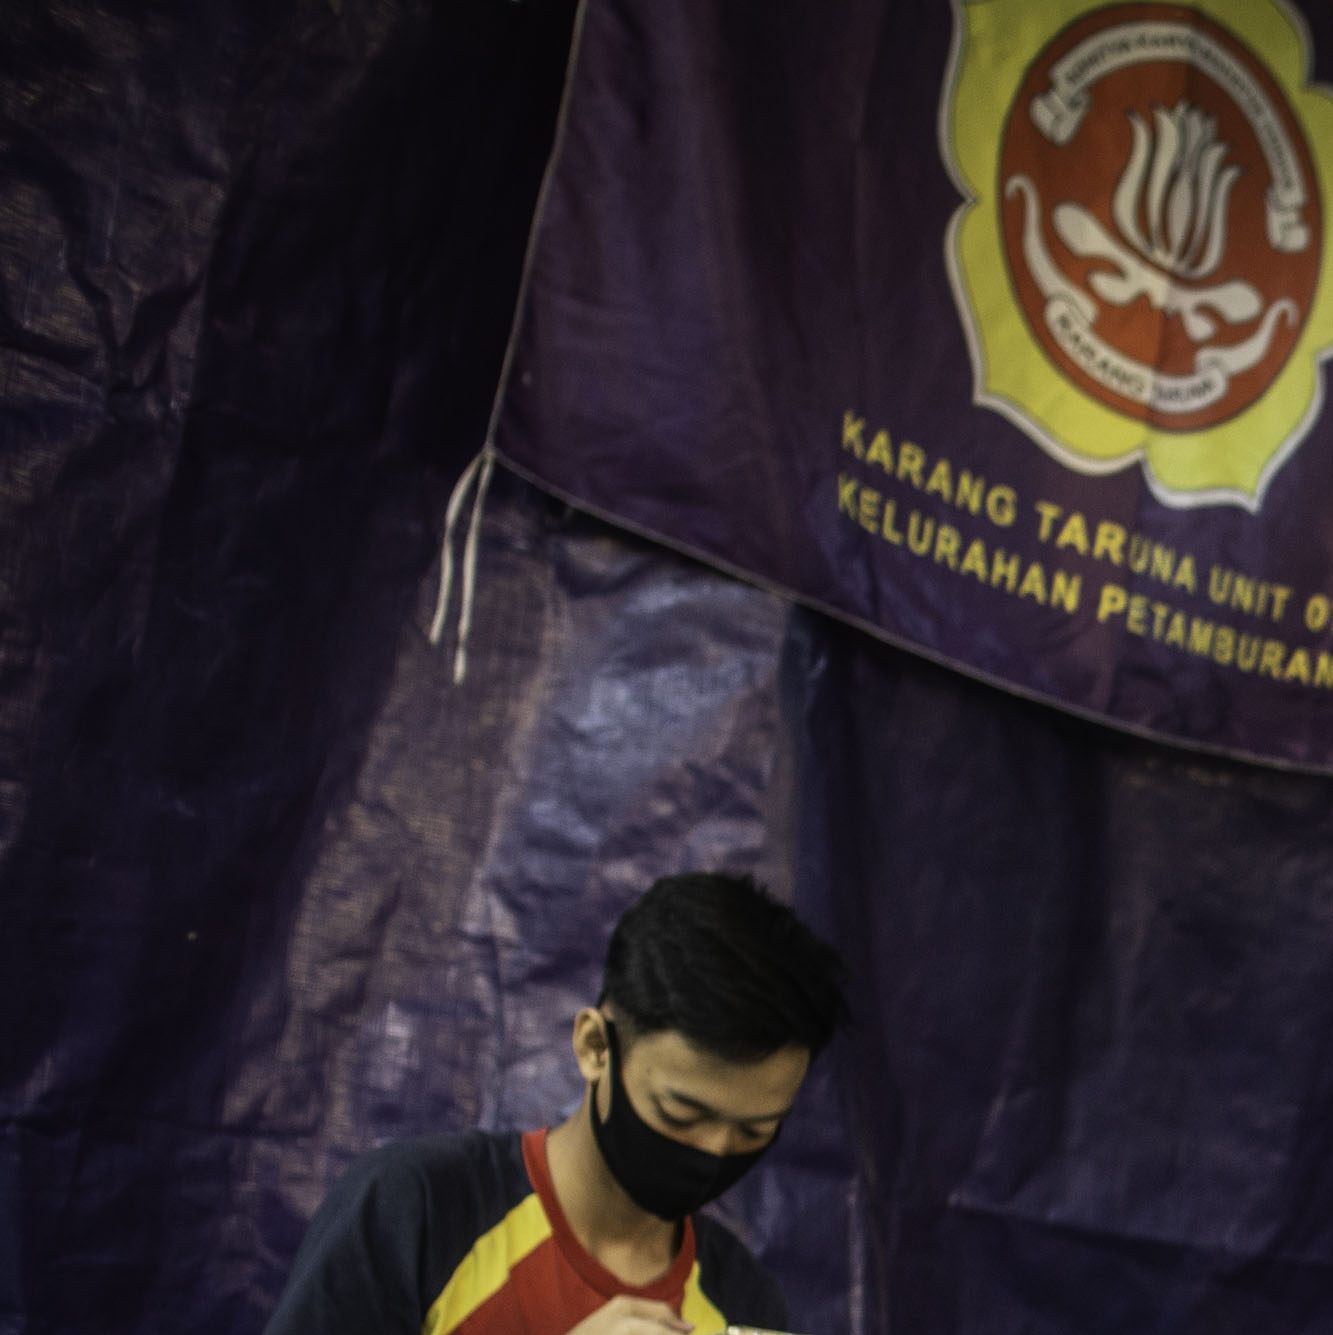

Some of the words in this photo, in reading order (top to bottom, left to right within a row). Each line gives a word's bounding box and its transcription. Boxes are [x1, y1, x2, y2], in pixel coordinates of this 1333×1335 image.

[837, 474, 1082, 613] KELURAHAN
[842, 409, 1018, 528] KARANG
[1035, 502, 1197, 594] TARUNA
[1208, 565, 1293, 623] UNIT
